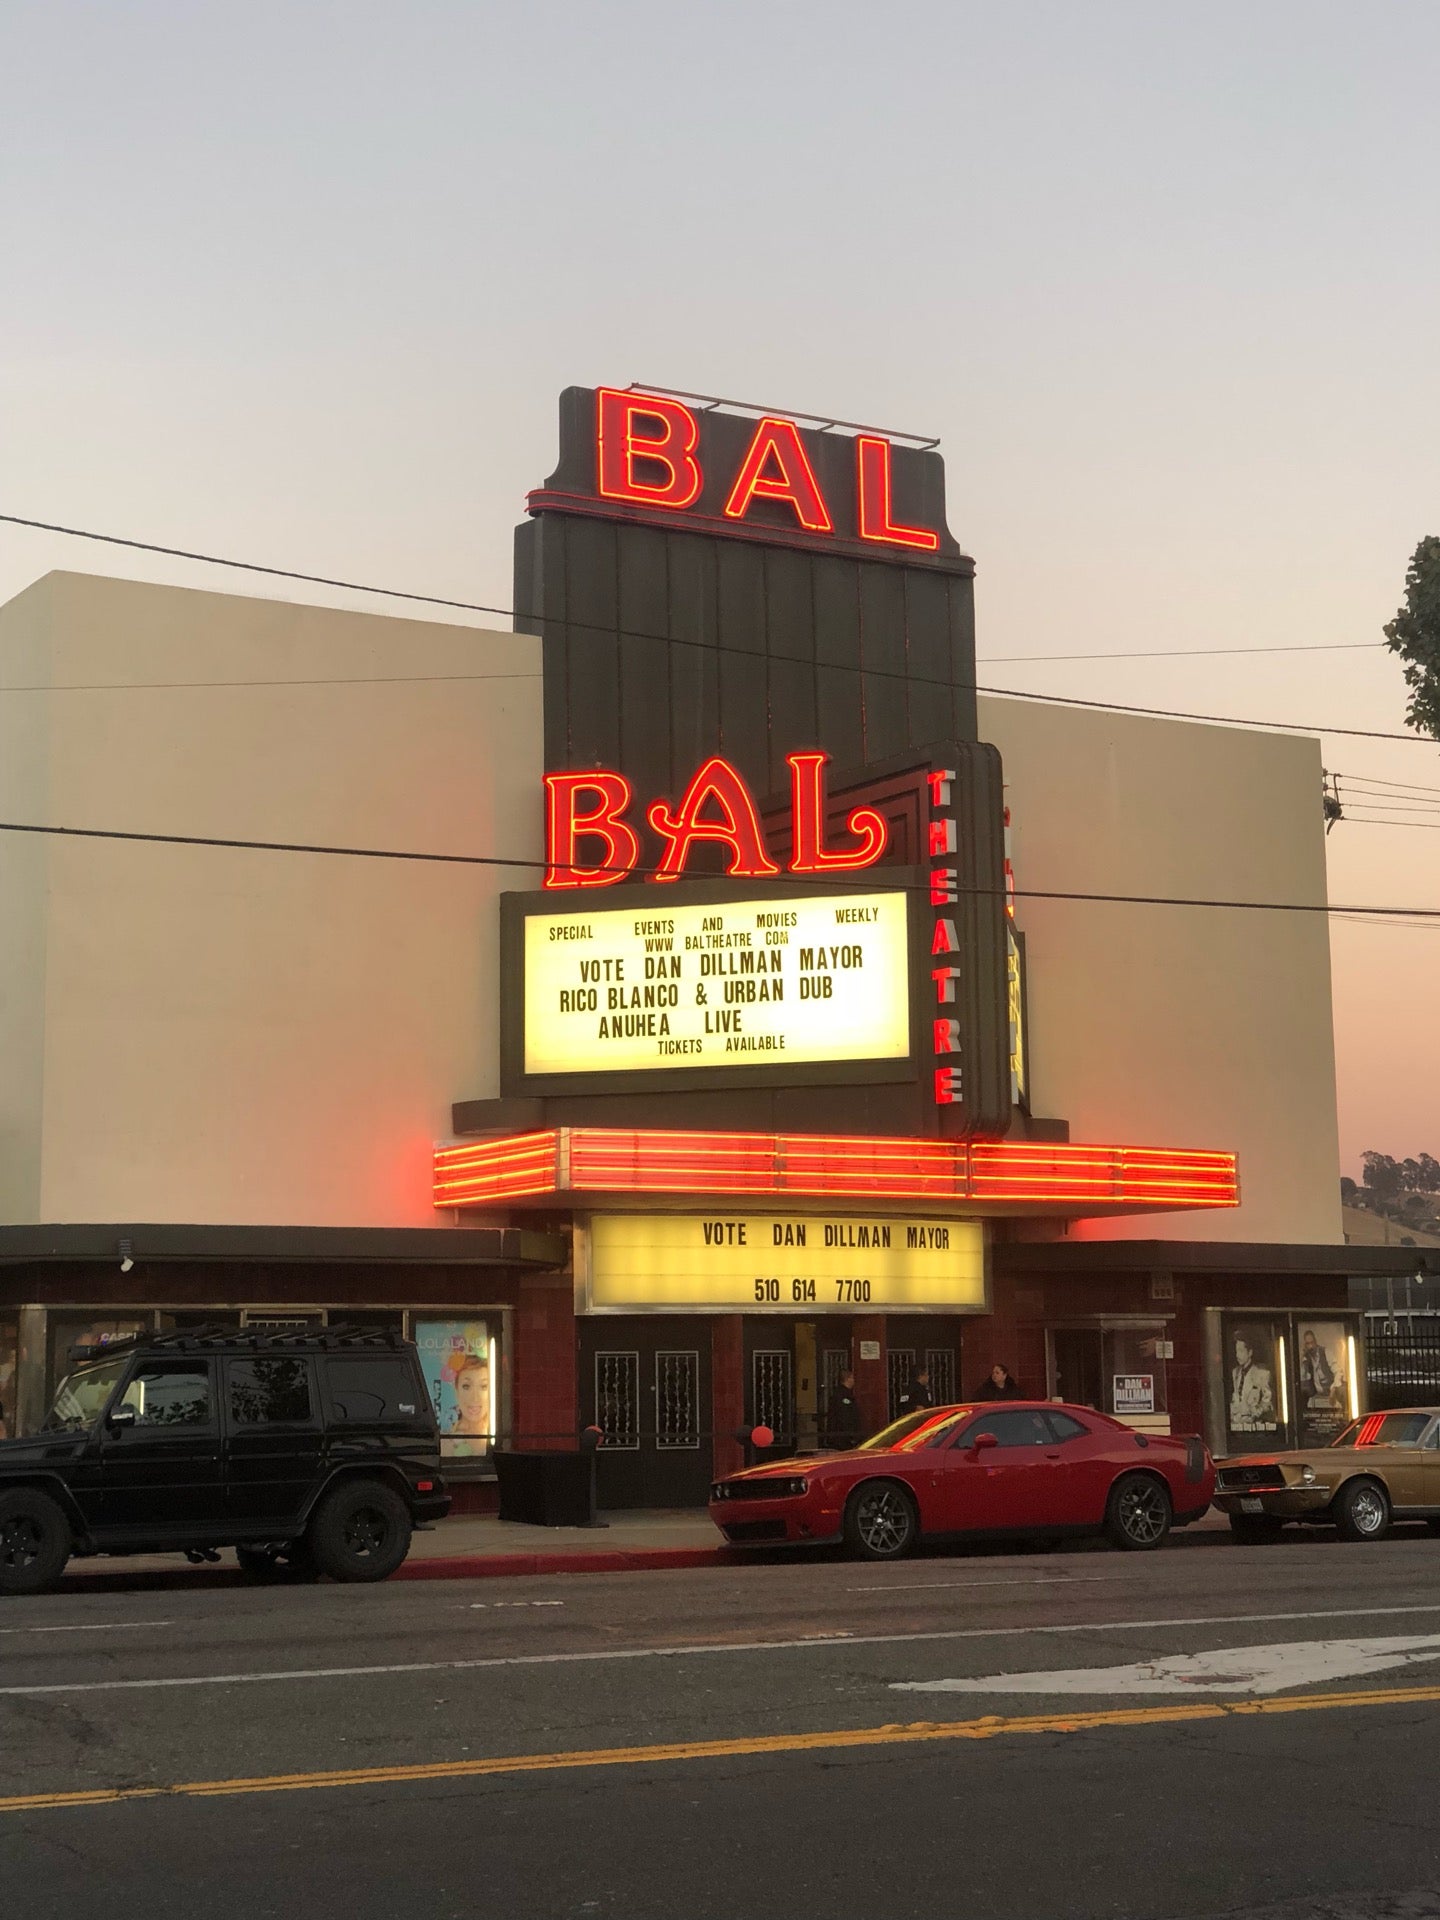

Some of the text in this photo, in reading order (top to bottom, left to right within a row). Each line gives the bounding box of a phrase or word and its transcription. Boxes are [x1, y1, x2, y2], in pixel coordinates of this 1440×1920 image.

[596, 386, 940, 551] BAL
[542, 751, 888, 889] BAL
[549, 907, 879, 941] SPECIAL EVENTS AND MOVIES WEEKLY
[927, 770, 963, 1104] THEATRE
[645, 931, 789, 952] WWW BALTHEATRE COM
[580, 945, 863, 983] VOTE DAN DILLMAN MAYOR
[560, 976, 833, 1012] RICO BLANCO & URBAN DUB
[598, 1009, 742, 1039] ANUHEA LIVE
[658, 1035, 786, 1055] TICKETS AVAILABLE
[703, 1222, 950, 1250] VOTE DAN DILLMAN MAYOR
[754, 1278, 871, 1302] 510 614 7700
[1116, 1389, 1152, 1401] DILLMAN
[1124, 1378, 1142, 1389] DAN
